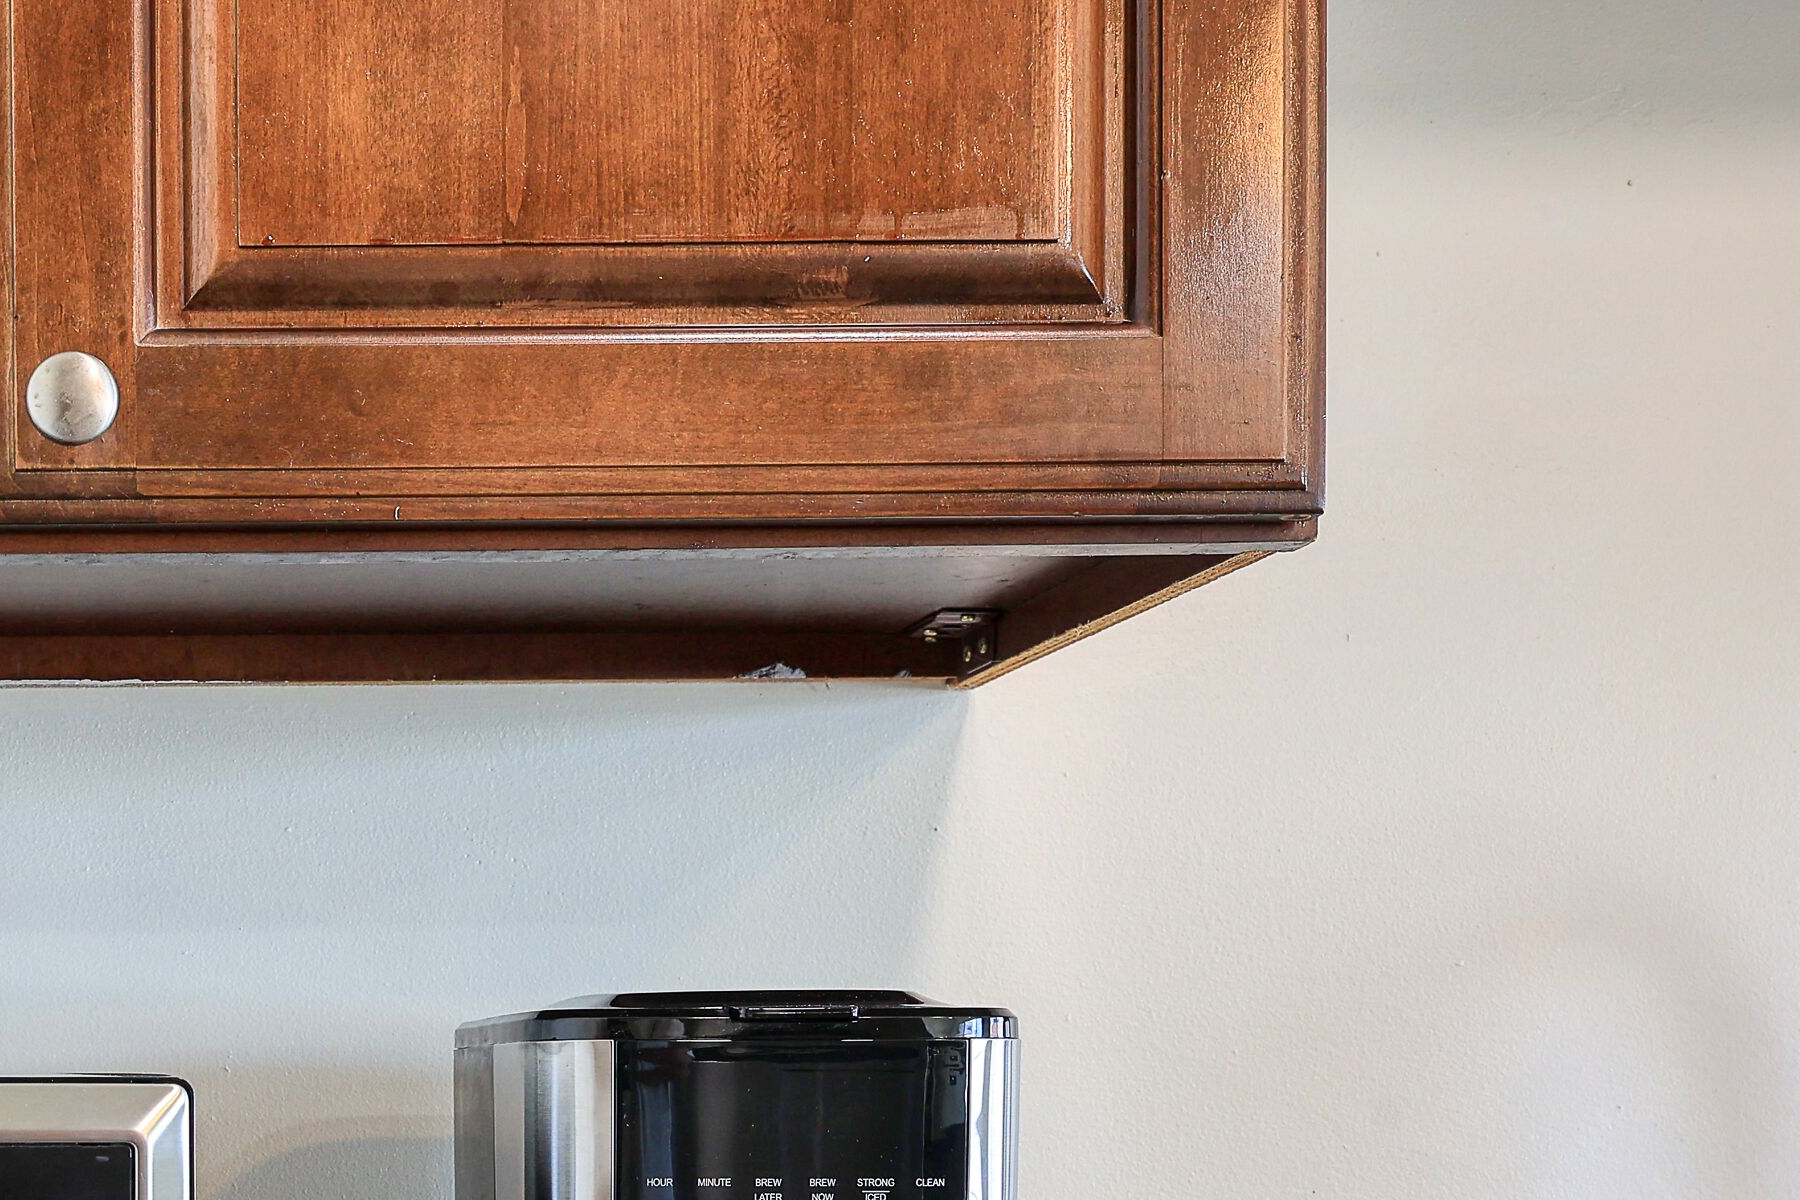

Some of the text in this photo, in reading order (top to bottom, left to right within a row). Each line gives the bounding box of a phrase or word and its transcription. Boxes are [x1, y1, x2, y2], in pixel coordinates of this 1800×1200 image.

[646, 1178, 673, 1187] HOUR
[697, 1178, 732, 1187] MINUTE
[755, 1178, 782, 1187] BREW
[809, 1178, 836, 1187] BREW
[857, 1178, 895, 1187] STRONG
[915, 1178, 945, 1187] CLEAN
